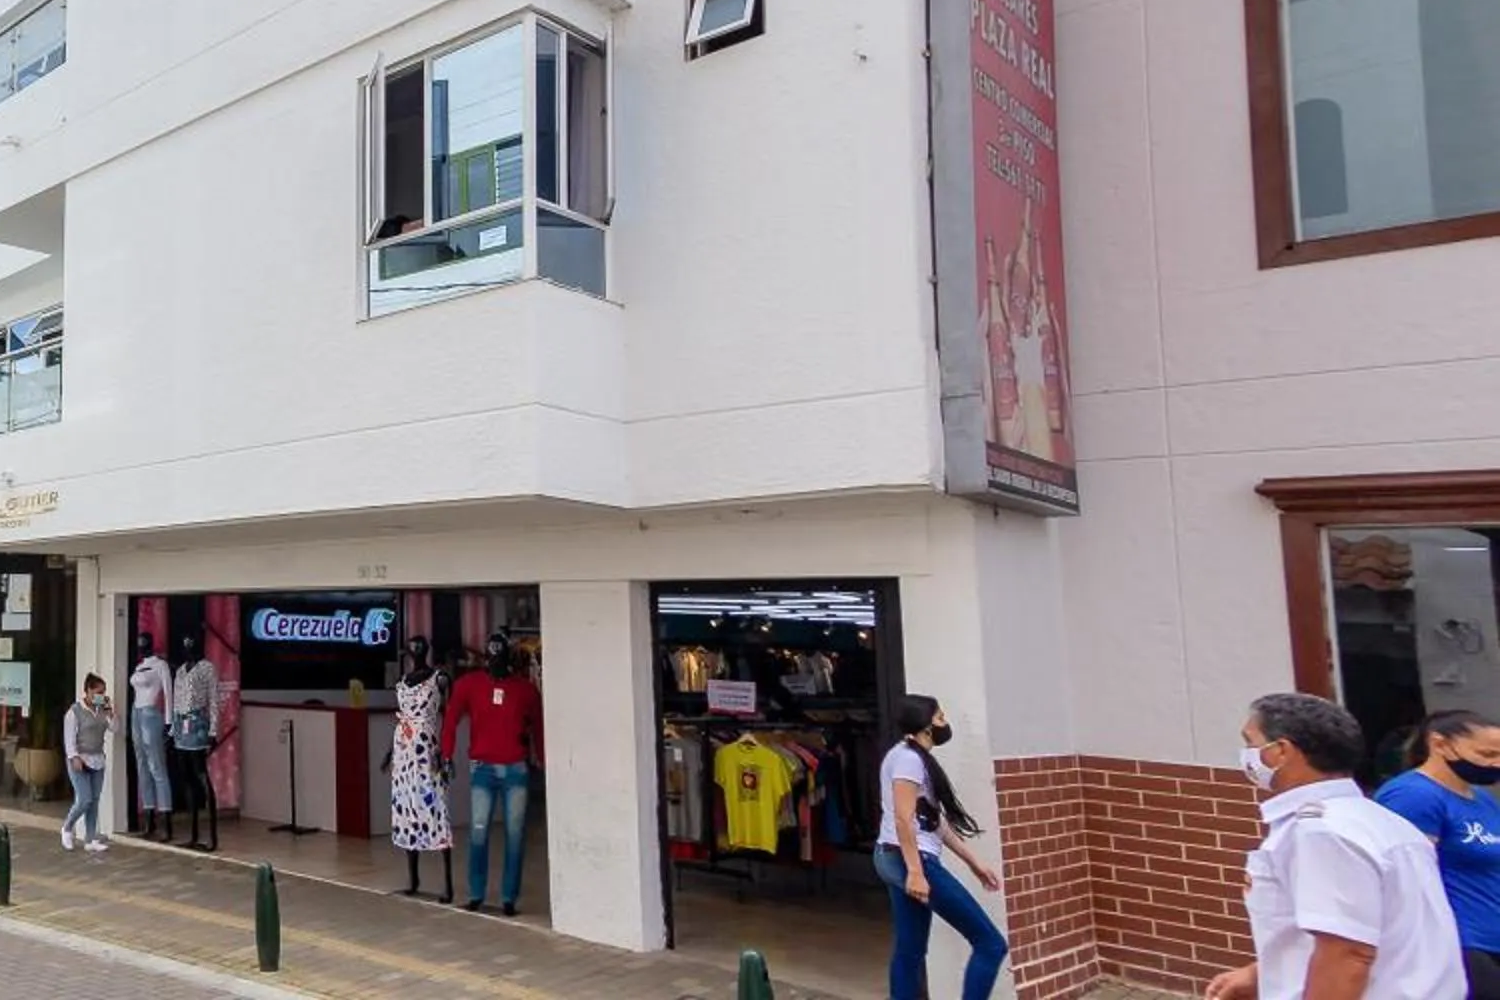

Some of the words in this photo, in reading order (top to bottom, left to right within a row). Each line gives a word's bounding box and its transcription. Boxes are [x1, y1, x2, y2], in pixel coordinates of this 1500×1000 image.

[973, 66, 1008, 112] CENTRO
[1020, 38, 1055, 100] REAL
[263, 611, 361, 639] Cerezuela
